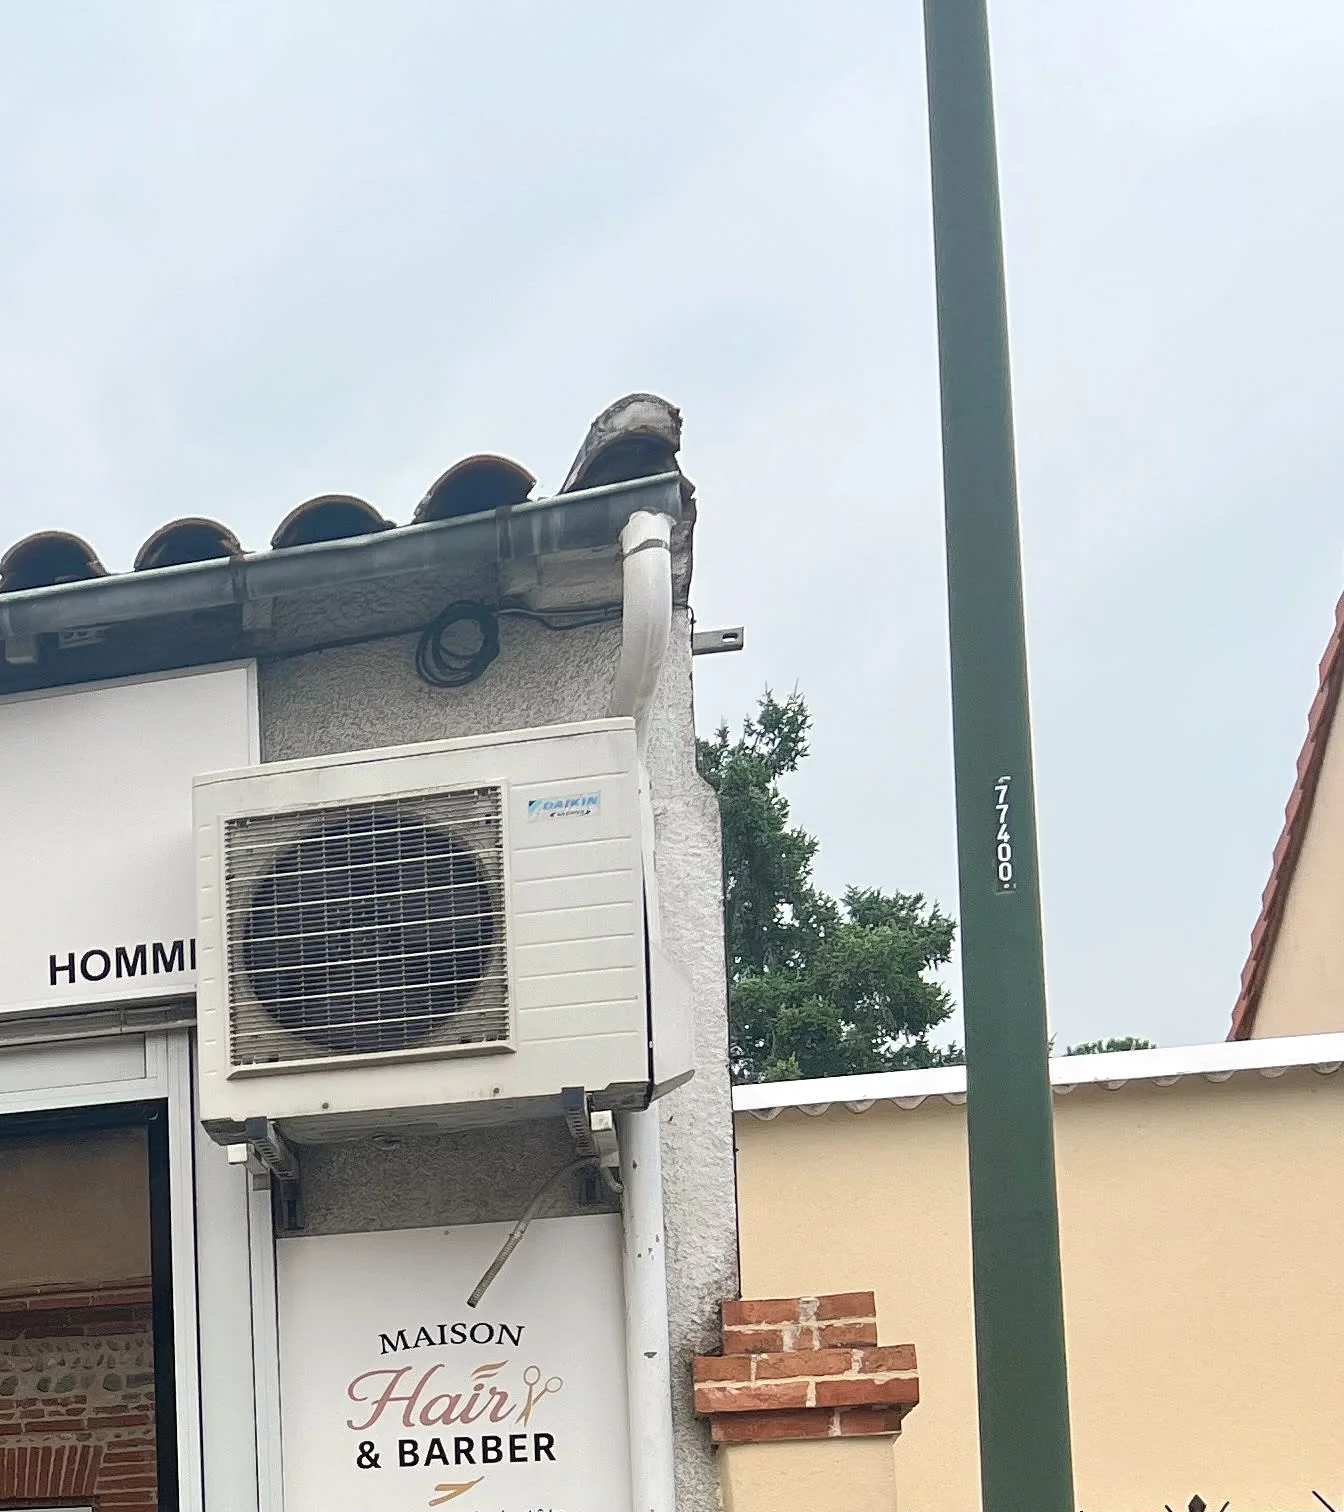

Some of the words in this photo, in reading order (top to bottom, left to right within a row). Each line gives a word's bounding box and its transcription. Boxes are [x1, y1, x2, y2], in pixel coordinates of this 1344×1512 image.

[543, 796, 599, 811] DAIKIN
[378, 1323, 525, 1355] MAISON
[346, 1363, 517, 1431] Hair
[357, 1441, 381, 1469] &
[399, 1433, 556, 1467] BARBER
